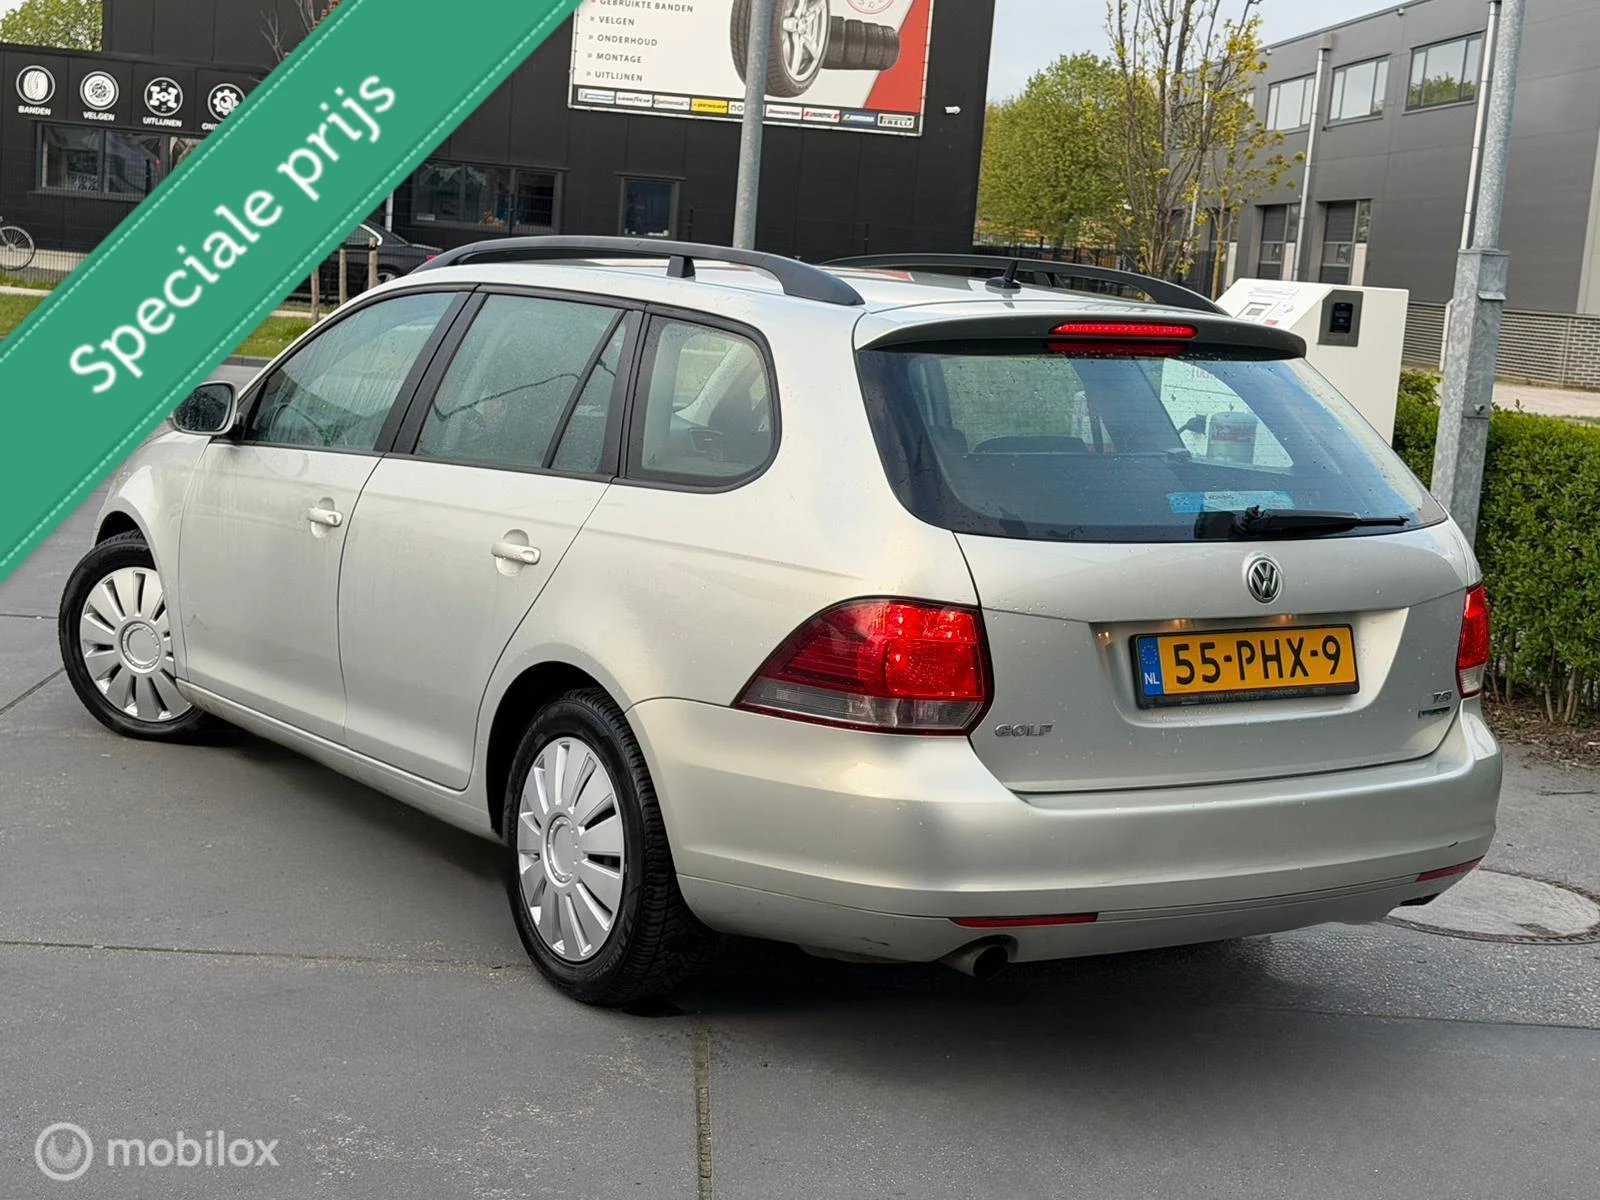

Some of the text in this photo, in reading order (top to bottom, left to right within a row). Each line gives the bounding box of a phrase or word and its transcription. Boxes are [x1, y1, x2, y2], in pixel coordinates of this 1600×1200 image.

[655, 2, 694, 12] BANDEN
[599, 16, 635, 26] VELGEN
[597, 34, 658, 46] ONDERHOUD
[596, 53, 642, 64] MONTAGE
[595, 71, 643, 82] UITLIJNEN
[18, 105, 51, 116] BANDEN
[83, 111, 115, 121] VELGEN
[142, 117, 182, 127] UITLIJNEN
[1173, 635, 1341, 686] 55-PHX-9
[1144, 671, 1160, 685] NL
[995, 724, 1053, 737] GOLF
